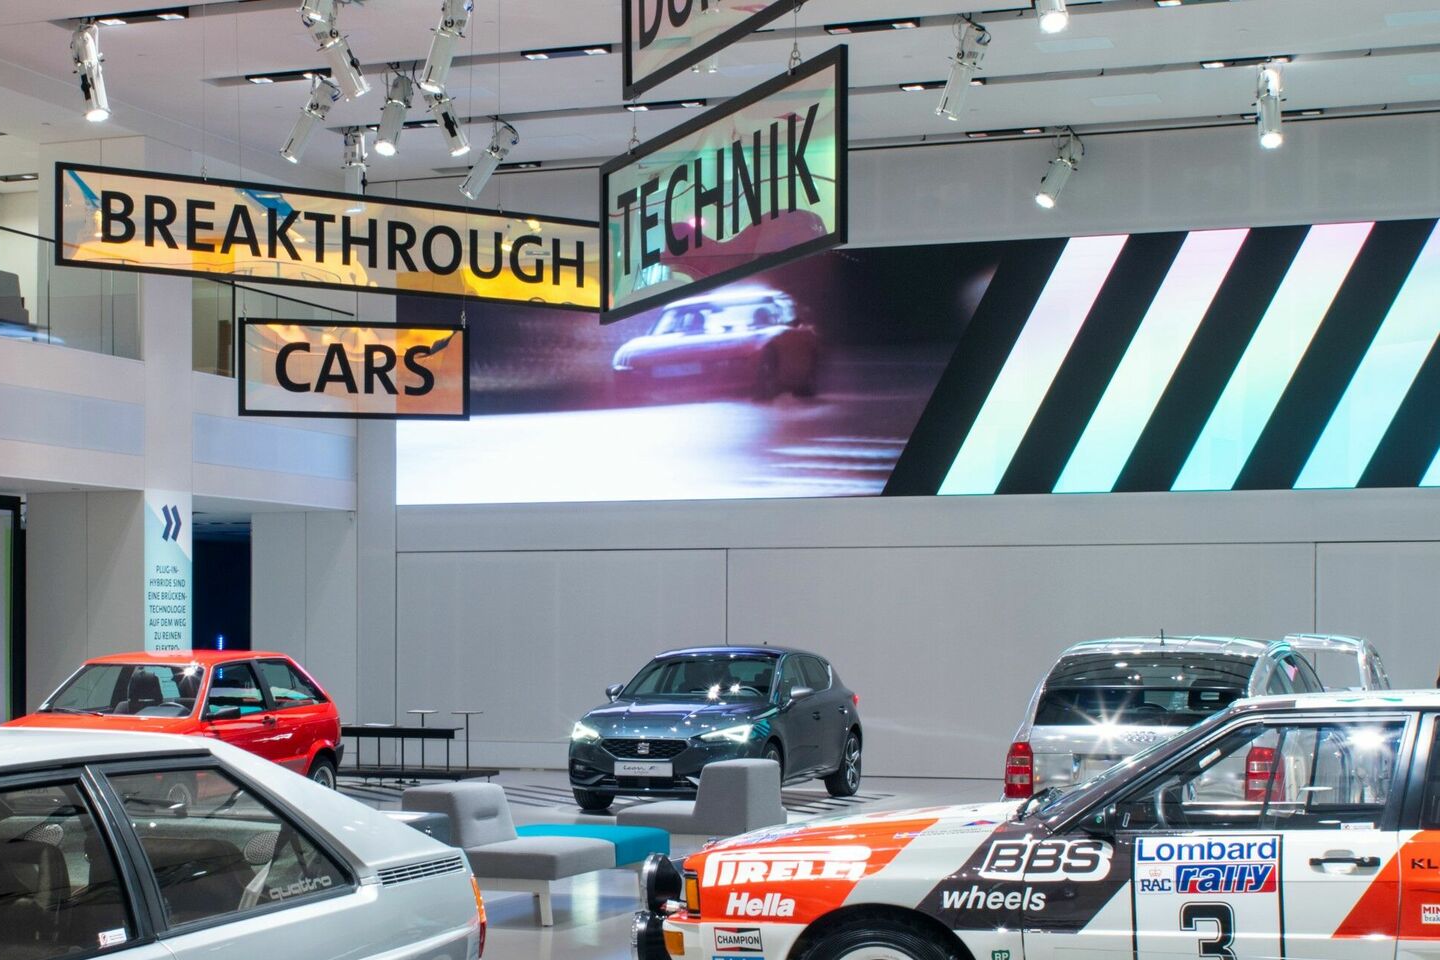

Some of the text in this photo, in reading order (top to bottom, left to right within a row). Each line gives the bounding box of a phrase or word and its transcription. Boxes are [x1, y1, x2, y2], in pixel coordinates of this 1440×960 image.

[617, 103, 820, 276] TECHNIK
[101, 190, 585, 288] BREAKTHROUGH
[274, 341, 436, 397] CARS
[156, 565, 179, 574] PLUG-IN-
[149, 578, 185, 588] HYBRIDE SIND
[148, 590, 188, 601] EINE BRÜCKEN-
[149, 605, 186, 614] TECHNOLOGIE
[149, 618, 187, 627] AUF DEM WEG
[154, 631, 182, 640] ZU REINEN
[979, 840, 1112, 880] BBS
[1137, 838, 1277, 862] Lombard
[701, 845, 872, 888] PIRELLI
[1178, 864, 1274, 893] rally
[269, 875, 332, 901] quattro
[1140, 878, 1172, 892] RAC
[725, 892, 796, 917] Hella
[943, 885, 1047, 911] wheels
[717, 935, 760, 944] CHAMPION
